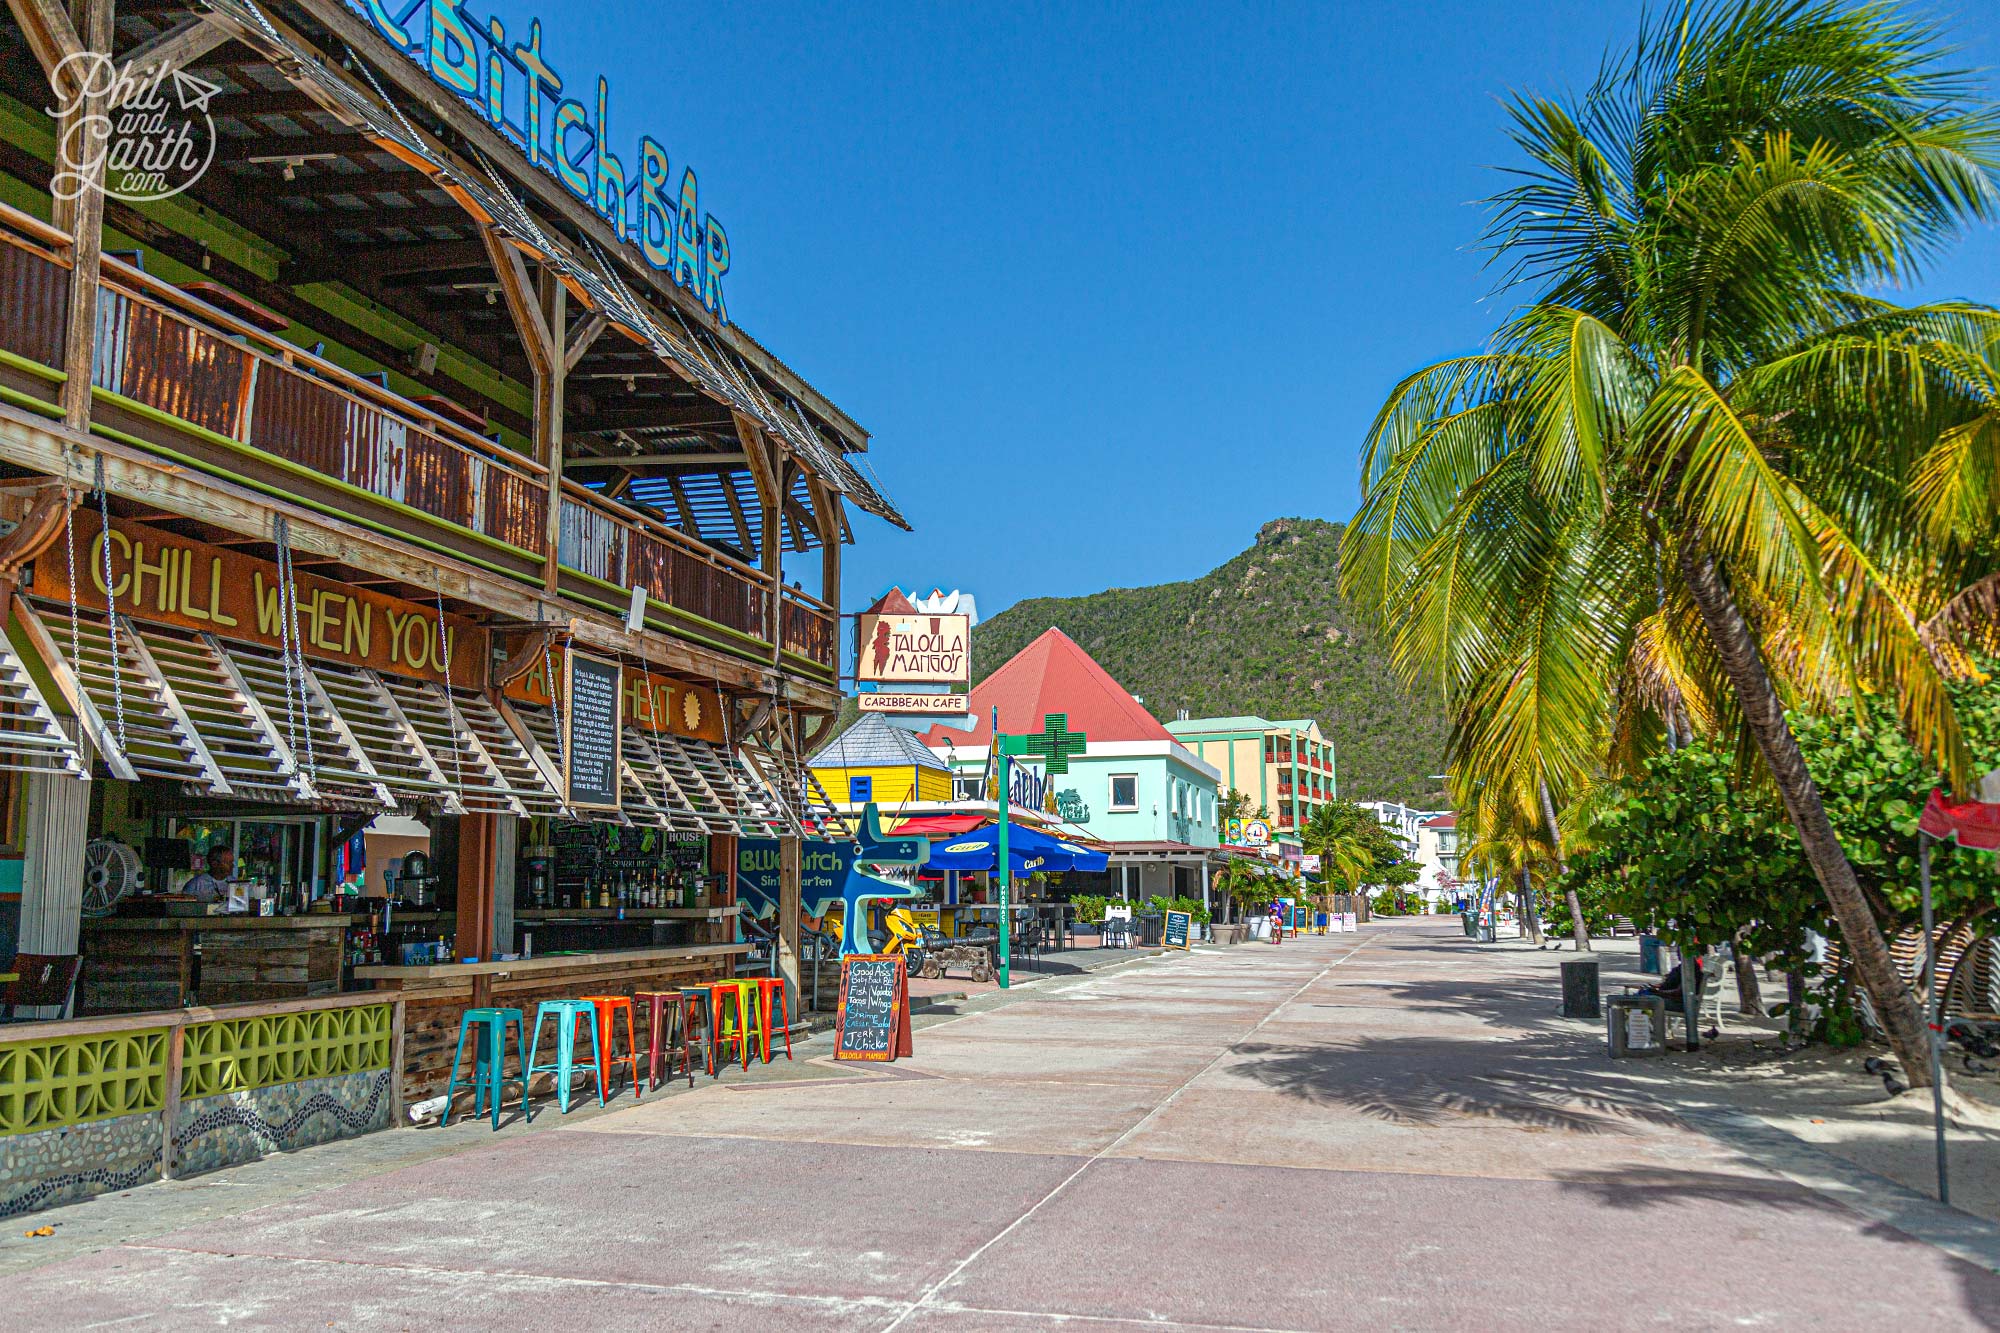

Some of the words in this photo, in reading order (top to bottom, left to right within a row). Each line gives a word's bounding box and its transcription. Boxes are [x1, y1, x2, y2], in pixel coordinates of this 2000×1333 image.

[637, 134, 731, 327] BAR
[91, 529, 238, 627] CHILL
[254, 572, 371, 658] WHEN
[386, 608, 455, 674] YOU
[892, 634, 963, 653] TALOULA
[864, 697, 929, 708] CARIBBEAN
[933, 698, 962, 709] CAFE
[1024, 856, 1045, 870] Carib
[852, 963, 874, 977] Good
[874, 964, 891, 977] Ass
[852, 975, 868, 986] Baby
[850, 985, 867, 996] Fish
[871, 996, 892, 1013] Wings
[855, 1036, 888, 1050] Chicken
